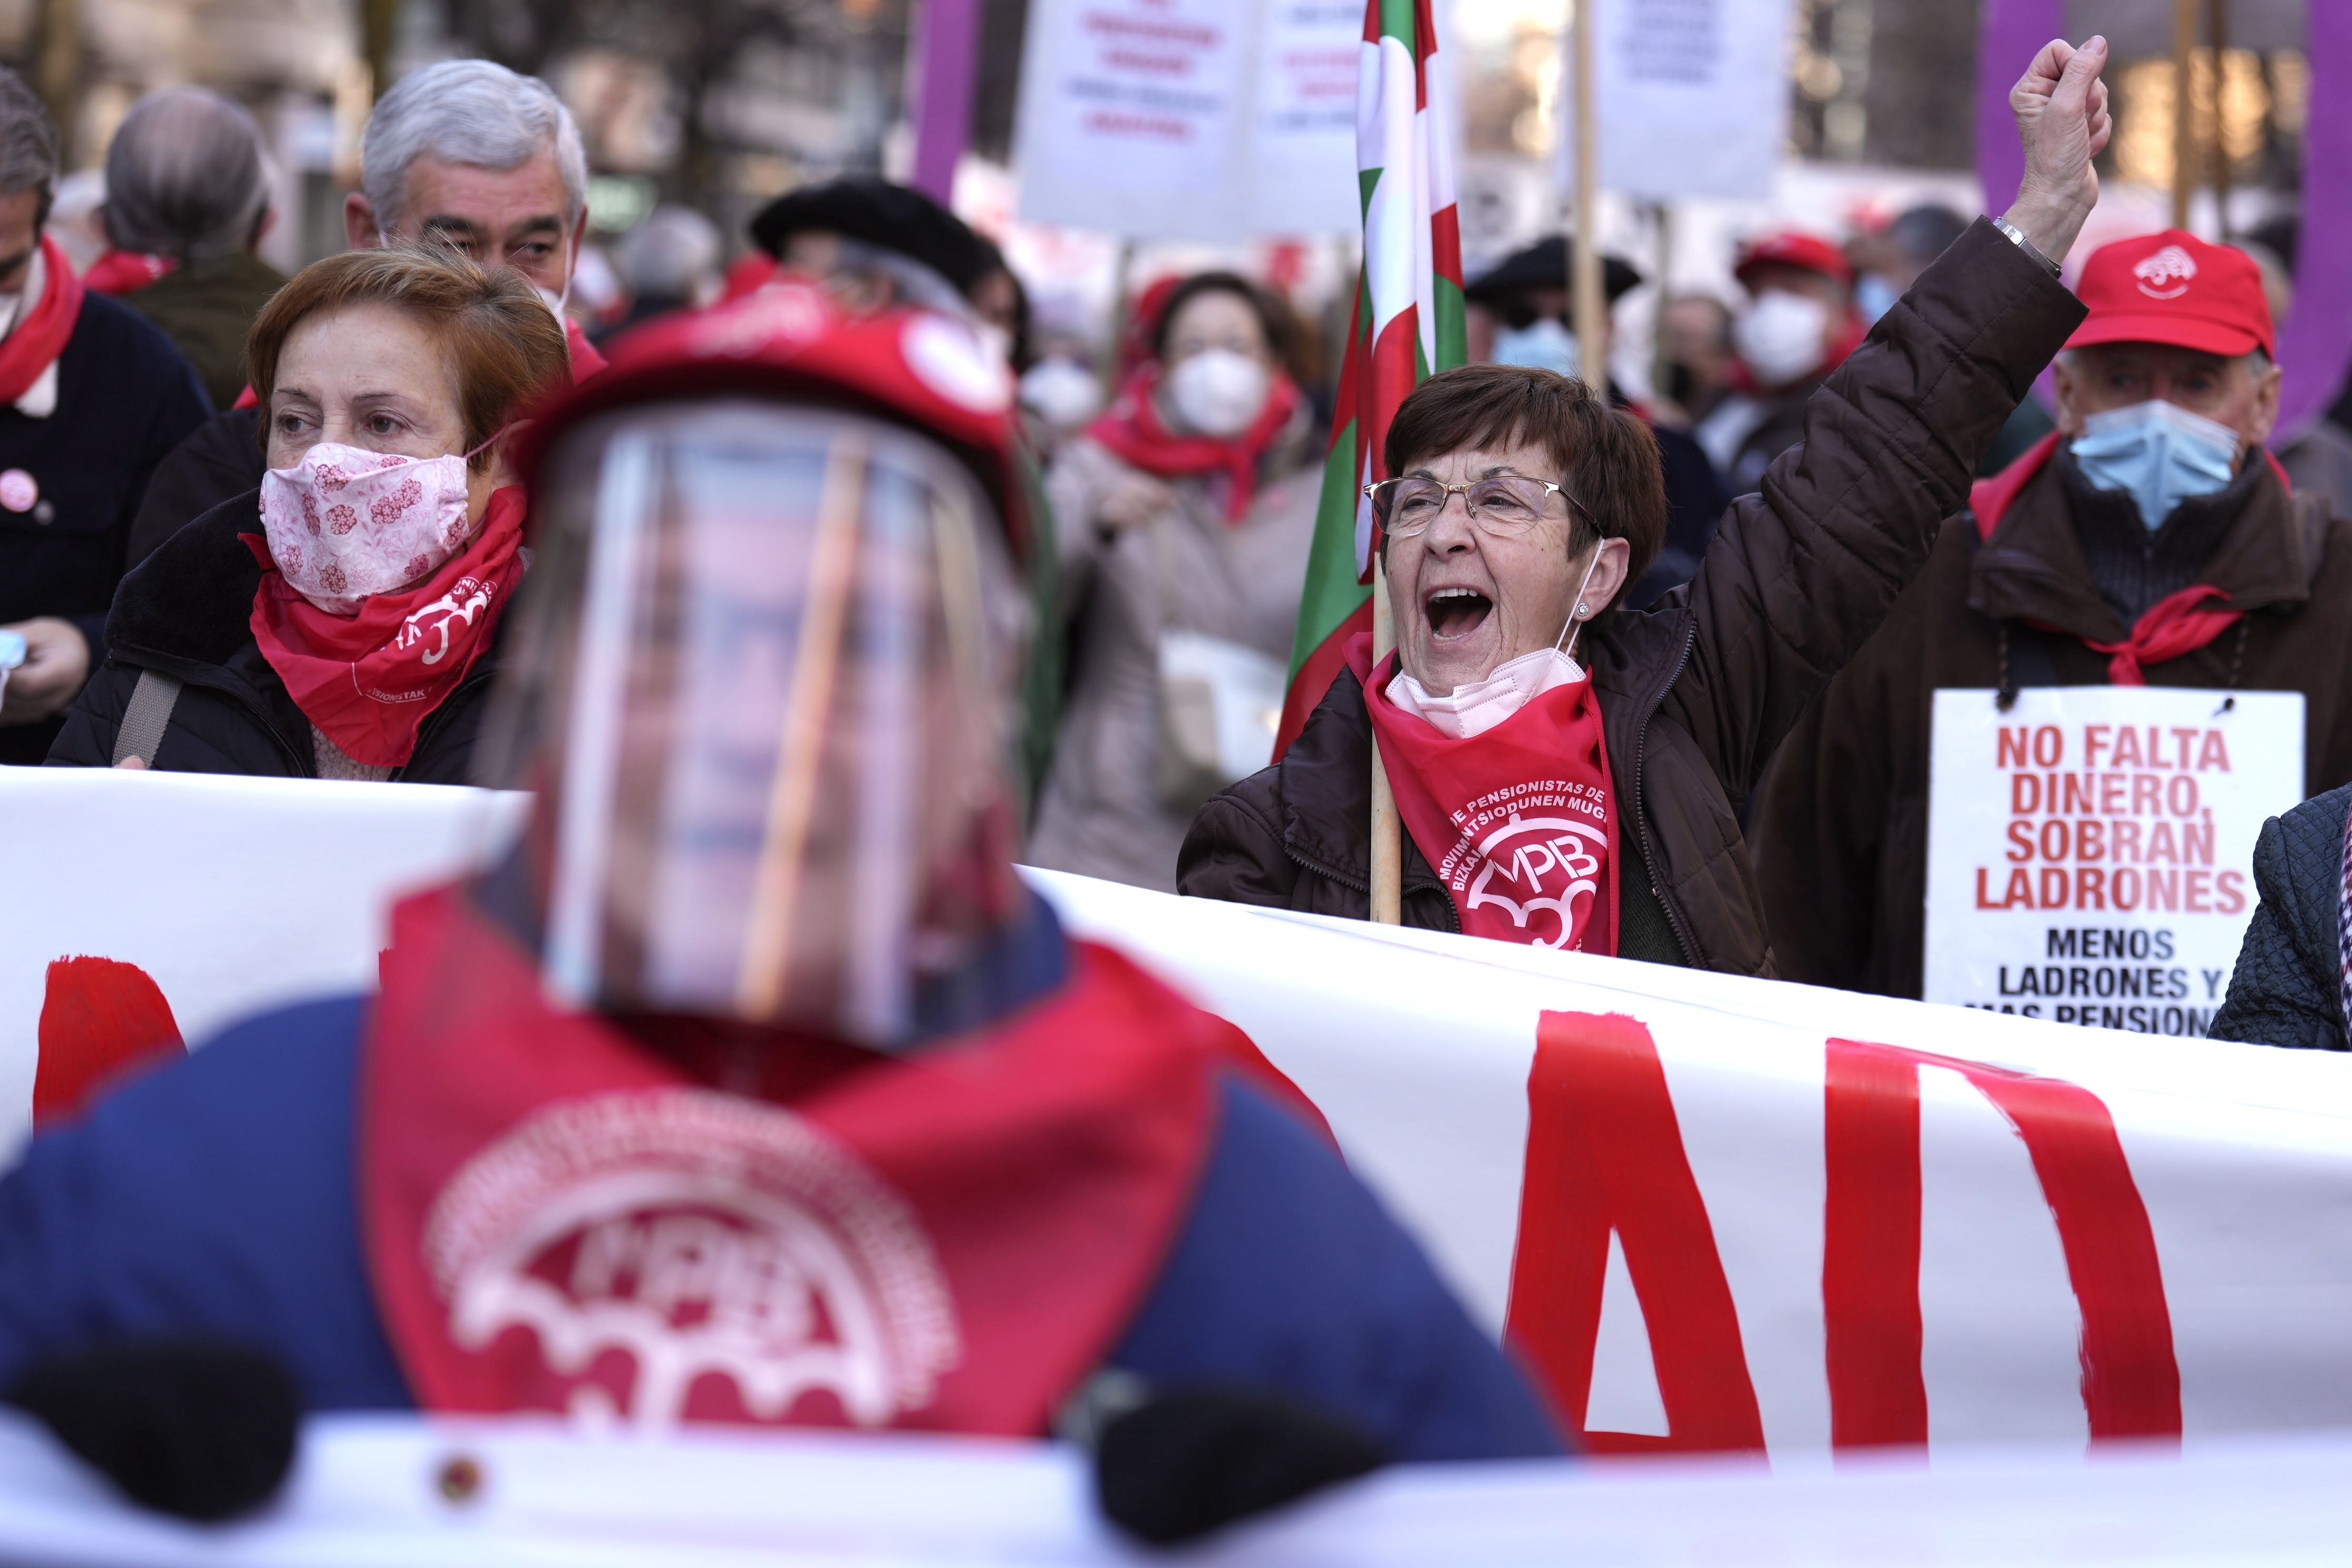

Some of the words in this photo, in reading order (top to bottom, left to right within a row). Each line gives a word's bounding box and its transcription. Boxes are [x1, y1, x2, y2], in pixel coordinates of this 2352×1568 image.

[1997, 725, 2064, 769] NO
[2084, 725, 2232, 773] FALTA
[1467, 780, 1584, 812] PENSIONISTAS
[1585, 786, 1605, 804] DE
[2005, 820, 2215, 865] SOBRAN
[1976, 867, 2246, 915] LADRONES
[2046, 928, 2174, 959] MENOS
[1999, 966, 2188, 998] LADRONES
[2202, 970, 2223, 999] Y
[2057, 1005, 2220, 1036] PENSION
